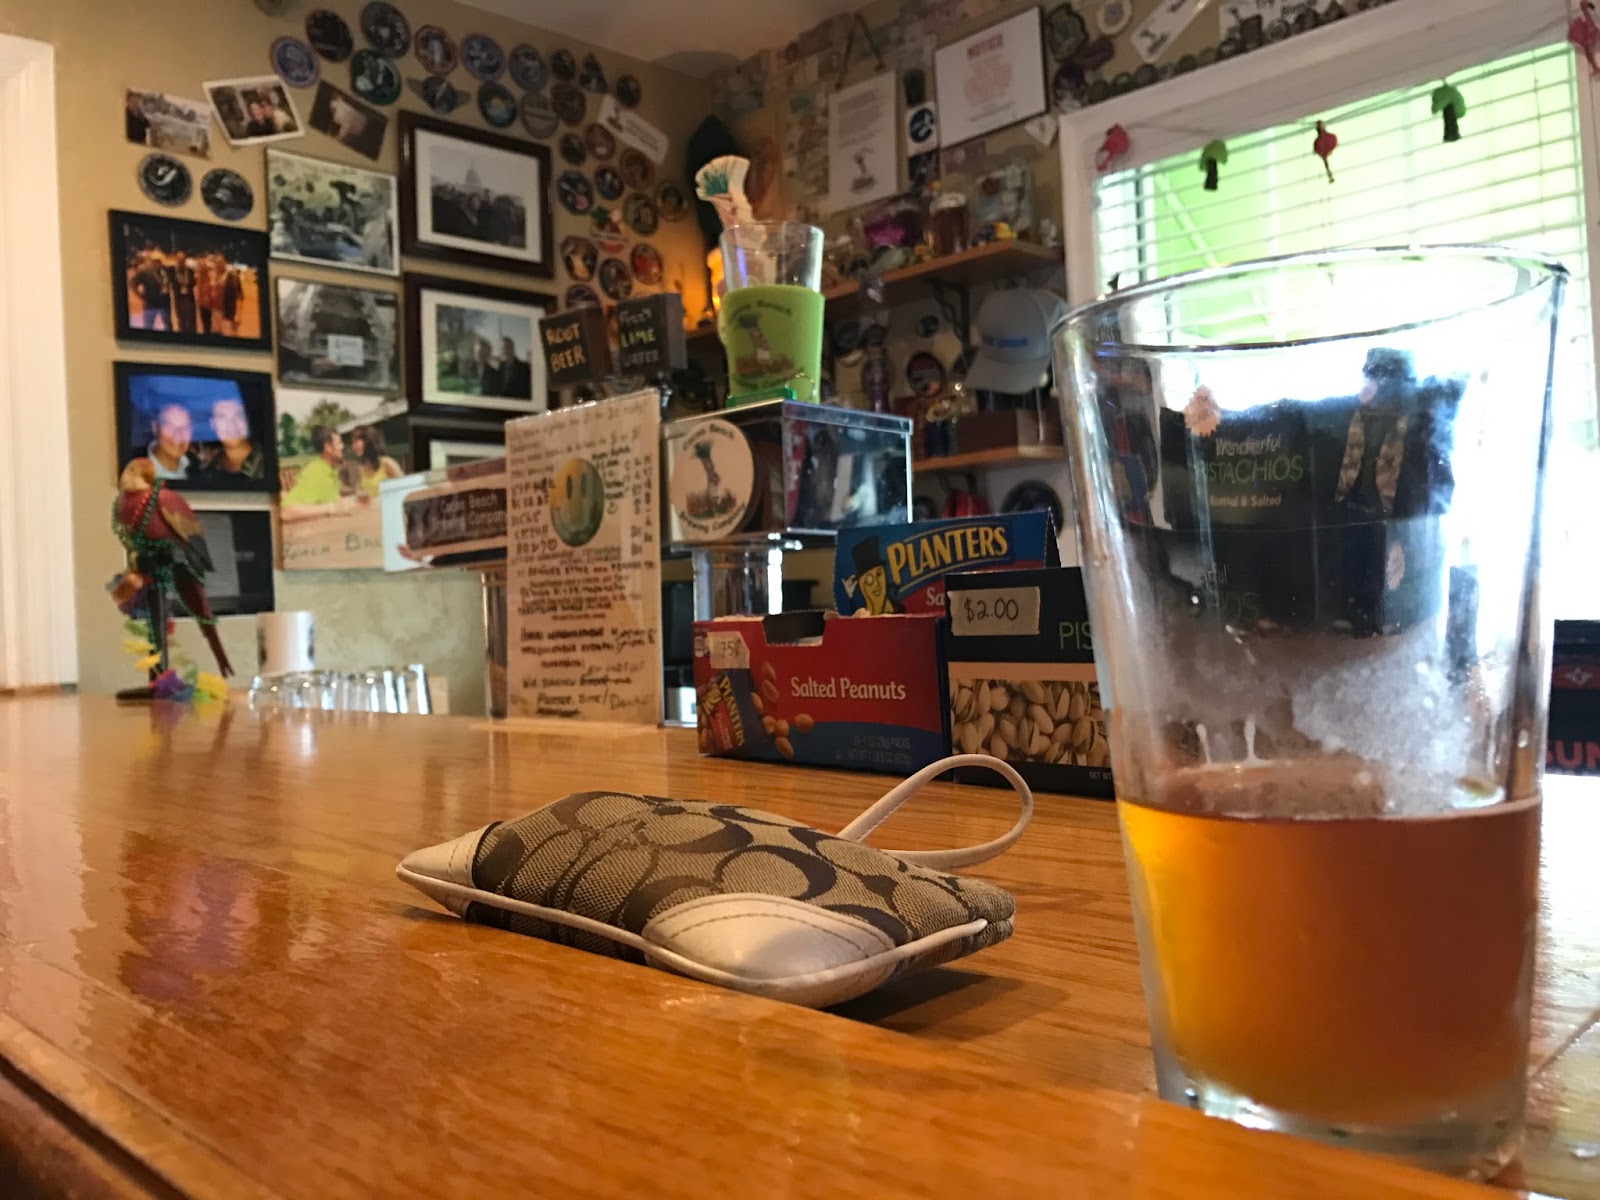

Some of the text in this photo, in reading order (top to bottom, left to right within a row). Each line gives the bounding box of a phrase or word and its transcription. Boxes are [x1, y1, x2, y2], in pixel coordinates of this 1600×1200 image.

[545, 323, 580, 346] ROOT
[620, 328, 656, 348] LIME
[550, 345, 586, 372] BEER
[1215, 433, 1281, 457] Wonderful
[1201, 455, 1304, 484] ISTACHIOS
[886, 526, 1008, 586] PLANTERS
[963, 597, 1019, 623] $2.00
[791, 676, 906, 701] Salted Peanuts
